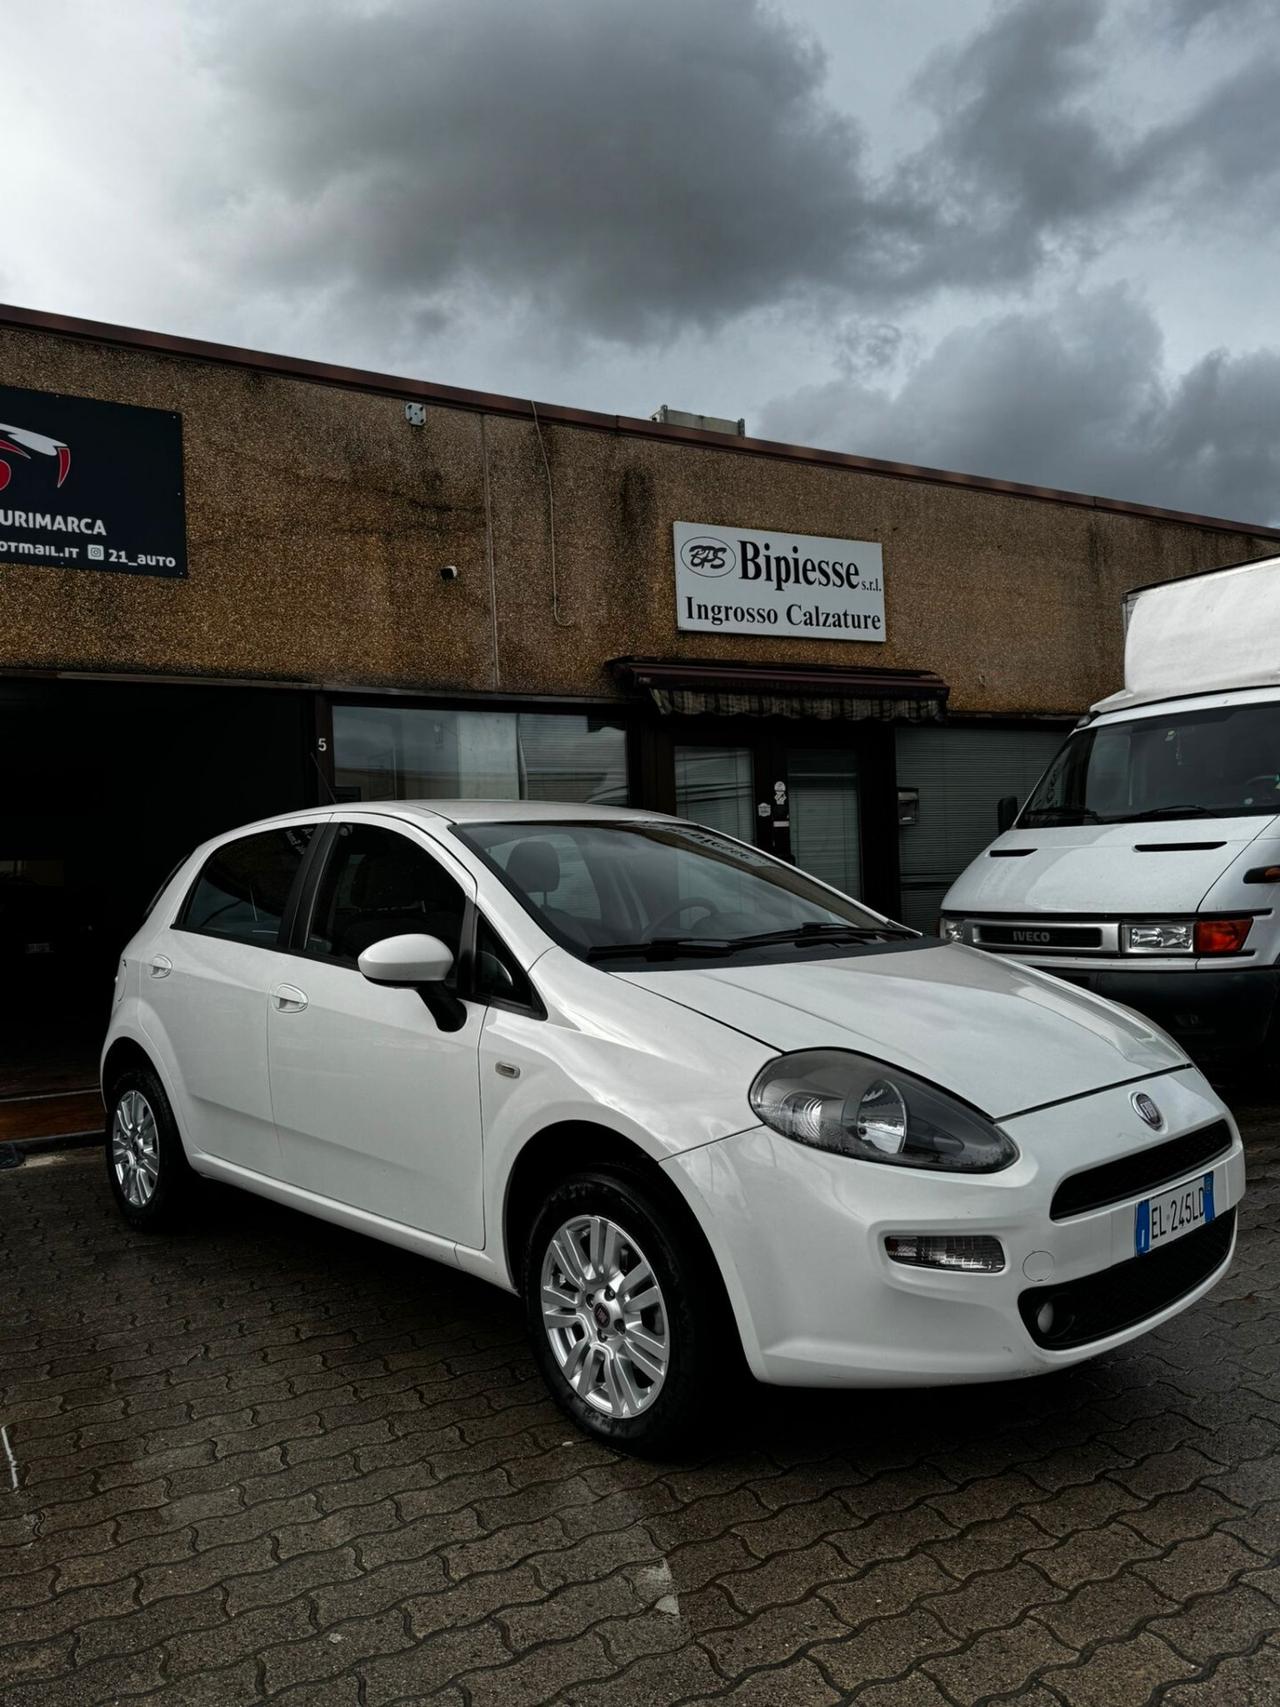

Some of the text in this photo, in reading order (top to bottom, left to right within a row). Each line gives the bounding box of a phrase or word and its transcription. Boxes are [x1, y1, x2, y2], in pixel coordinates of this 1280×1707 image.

[737, 539, 882, 592] Bipiesse s.r.l.
[685, 595, 881, 630] Ingrosso Calzature
[318, 737, 327, 751] 5
[1012, 930, 1050, 943] IVECO
[1151, 1204, 1167, 1240] EL
